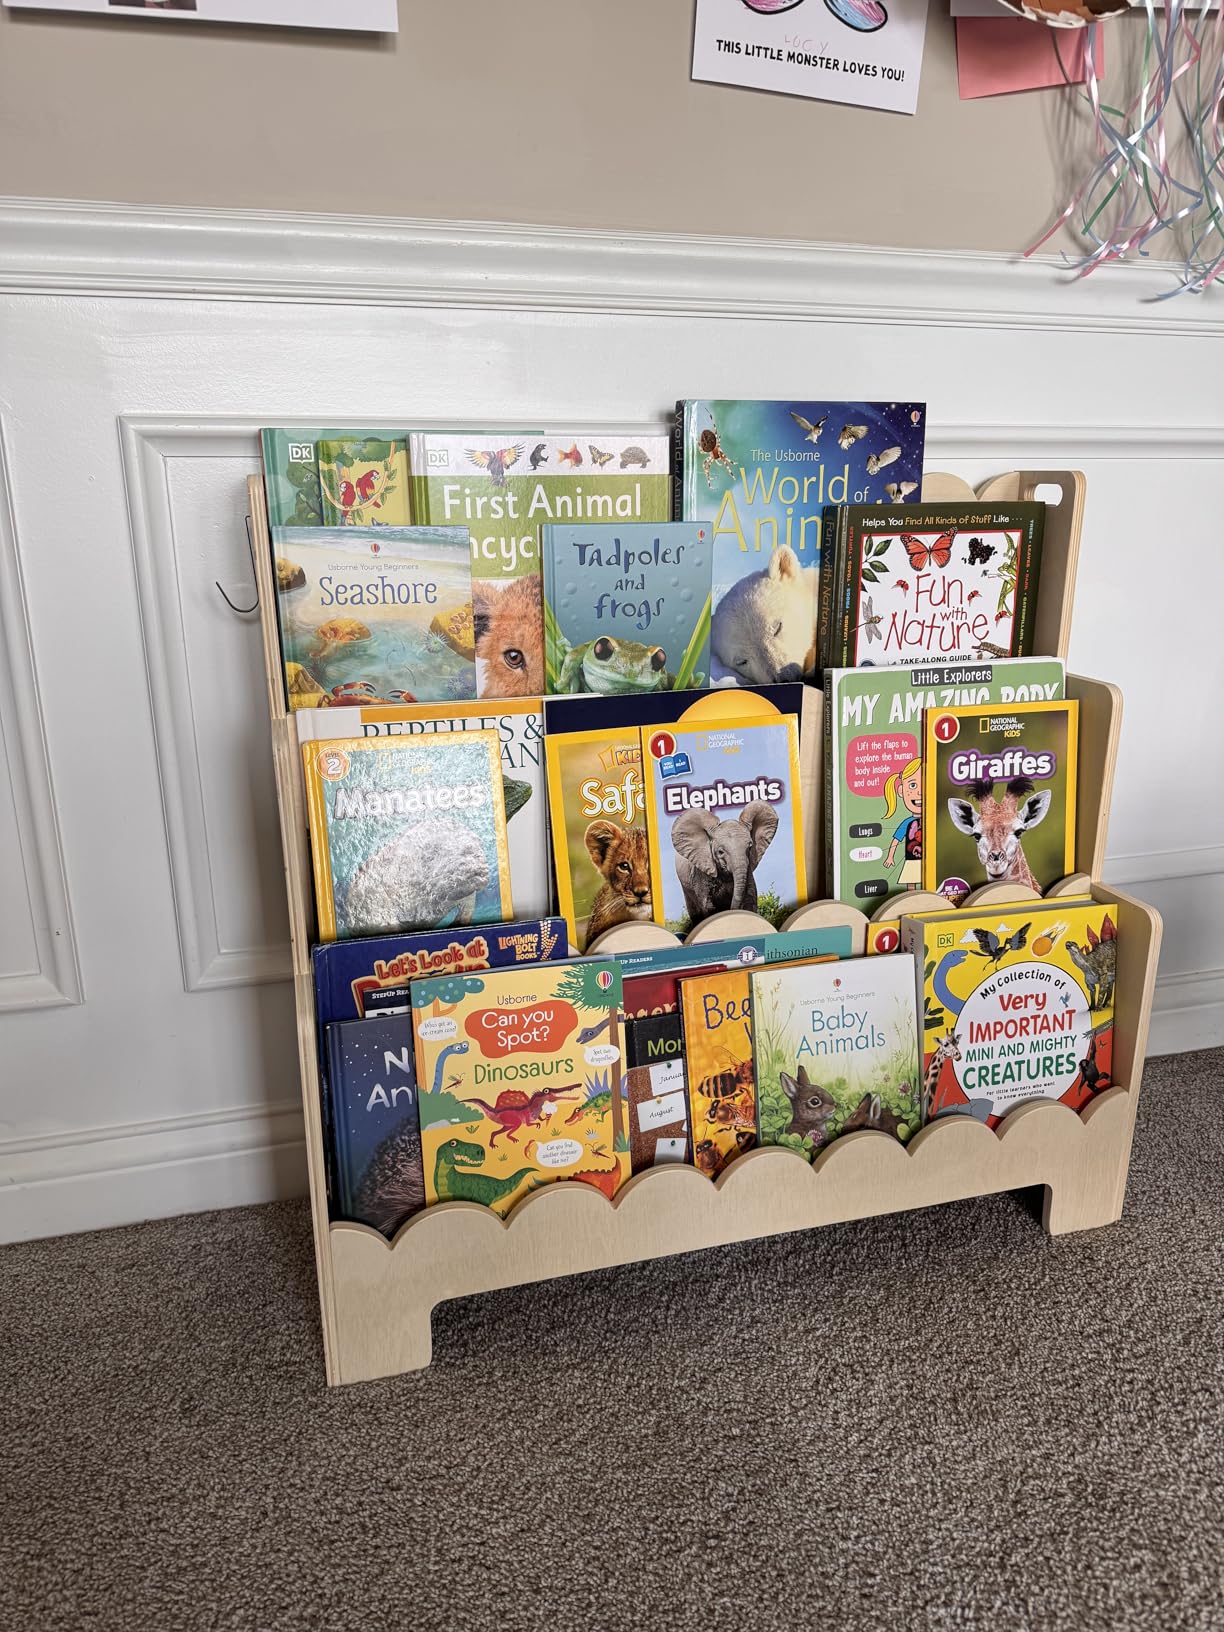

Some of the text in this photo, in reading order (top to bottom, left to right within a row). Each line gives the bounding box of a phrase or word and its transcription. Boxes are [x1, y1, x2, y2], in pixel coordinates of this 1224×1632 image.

[716, 39, 905, 82] THIS LITTLE MONSTER LOVES YOU!
[291, 445, 311, 459] DK
[430, 452, 446, 464] DK
[751, 449, 820, 462] The Usborne
[740, 464, 870, 505] World of
[443, 483, 641, 520] First Animal
[862, 518, 886, 528] Helps
[888, 517, 903, 526] You
[905, 517, 922, 526] Find
[924, 516, 934, 525] All
[935, 516, 957, 525] Kinds
[959, 515, 969, 524] of
[971, 515, 992, 524] Stuff
[573, 538, 685, 574] Tadpoles
[328, 563, 419, 572] Usborne Young Beginners
[319, 576, 438, 606] Seashore
[615, 574, 645, 591] and
[915, 573, 963, 613] Fun
[593, 593, 665, 630] frogs
[820, 586, 832, 636] Nature
[940, 606, 967, 621] with
[884, 609, 989, 652] Nature
[900, 654, 972, 665] TAKE-ALONG GUIDE
[912, 668, 992, 684] Little Explorers
[842, 693, 880, 727] MY
[524, 714, 544, 740] &
[941, 722, 949, 737] 1
[990, 717, 1017, 725] NATIONAL
[990, 722, 1025, 731] GEOGRAPHIC
[657, 740, 666, 755] 1
[857, 740, 908, 751] Lift the flaps to
[615, 749, 640, 766] KID
[855, 751, 913, 764] explore the human
[952, 750, 1051, 779] Giraffes
[327, 758, 341, 775] 2
[855, 766, 870, 776] body
[854, 777, 880, 788] and out!
[334, 780, 486, 819] Manatees
[582, 771, 646, 822] Safa
[666, 779, 781, 811] Elephants
[858, 827, 873, 837] Lungs
[858, 850, 872, 859] Heart
[864, 884, 877, 894] Liver
[498, 933, 539, 950] LIGHTNING
[515, 942, 537, 955] BOLT
[882, 935, 890, 950] 1
[939, 936, 952, 945] DK
[376, 956, 418, 980] Let's
[418, 945, 464, 970] Look
[466, 939, 485, 958] at
[516, 953, 538, 961] BOOKS
[767, 946, 818, 960] ithsonian
[980, 969, 1066, 1000] My Collection of
[497, 994, 537, 1006] Usborne
[800, 991, 875, 1006] Usborne Young Beginners
[998, 992, 1047, 1011] Very
[481, 1009, 554, 1029] Can you
[703, 993, 751, 1030] Bee
[812, 1005, 868, 1033] Baby
[969, 1009, 1076, 1044] IMPORTANT
[497, 1025, 550, 1051] Spot?
[796, 1024, 886, 1059] Animals
[965, 1034, 1077, 1063] MINI AND MIGHTY
[474, 1058, 574, 1085] Dinosaurs
[962, 1052, 1077, 1090] CREATURES
[649, 1106, 674, 1119] August
